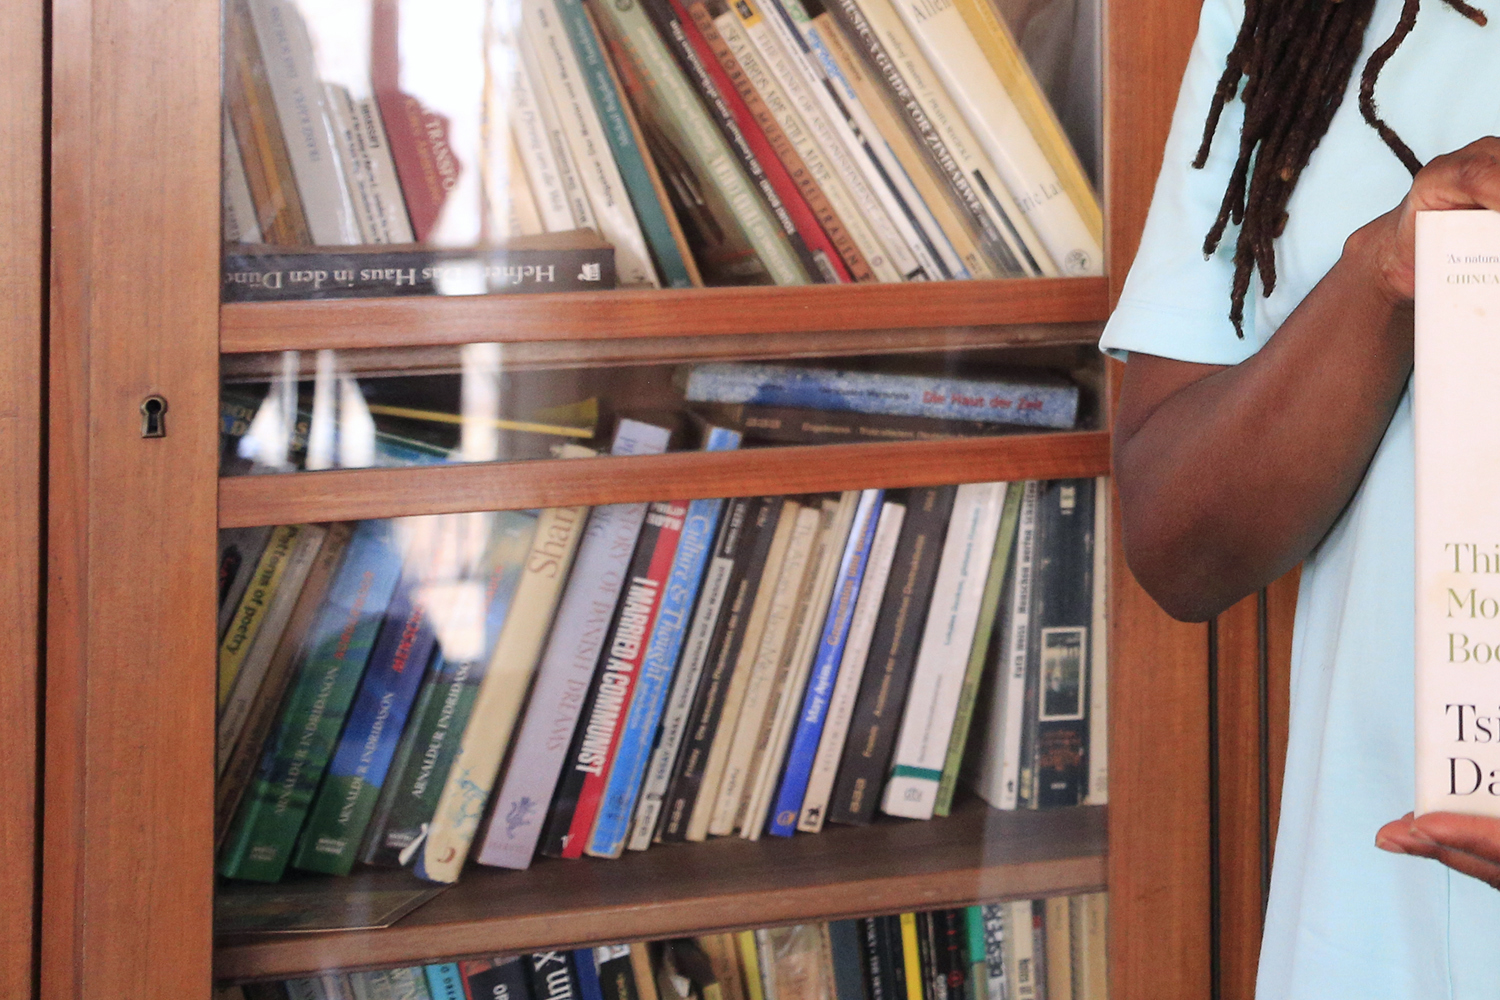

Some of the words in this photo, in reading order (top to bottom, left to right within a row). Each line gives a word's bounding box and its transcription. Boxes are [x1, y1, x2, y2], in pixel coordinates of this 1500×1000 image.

[873, 51, 910, 101] GUIDE
[904, 99, 932, 133] FOR
[925, 131, 982, 213] ZIMBABWE
[415, 118, 467, 192] TRANSFO
[716, 47, 758, 108] ROBERT
[791, 167, 821, 204] DREI
[815, 205, 860, 267] FRAUEN
[747, 157, 763, 176] Ein
[758, 177, 781, 209] BOUKI
[774, 205, 796, 235] TOUKI
[289, 270, 328, 288] den
[333, 269, 354, 286] in
[360, 268, 415, 285] Haus
[1446, 273, 1500, 285] CHINUA
[921, 390, 945, 405] Die
[950, 392, 985, 408] Haut
[988, 395, 1011, 409] der
[1016, 397, 1043, 412] Zeit
[257, 523, 300, 589] Patterns
[672, 512, 712, 582] Culture
[249, 587, 268, 607] of
[596, 568, 621, 596] OF
[631, 573, 659, 589] I
[666, 582, 691, 605] &
[1015, 565, 1031, 614] Menschen
[222, 604, 260, 657] poetry
[569, 599, 611, 672] DANISH
[608, 583, 656, 662] MARRIED
[640, 604, 685, 683] Thought
[605, 657, 633, 675] A
[811, 662, 834, 696] Ayim
[542, 676, 586, 755] DREAMS
[573, 668, 631, 778] COMMUNIST
[804, 694, 825, 724] May
[271, 745, 310, 816] ARNALDUR
[297, 663, 341, 747] INDRIDASON
[409, 728, 447, 799] ARNALDUR
[435, 658, 473, 730] INDRIDASO
[335, 762, 370, 826] ARNALDUR
[356, 688, 397, 764] INDRIDASON
[532, 948, 567, 971] X
